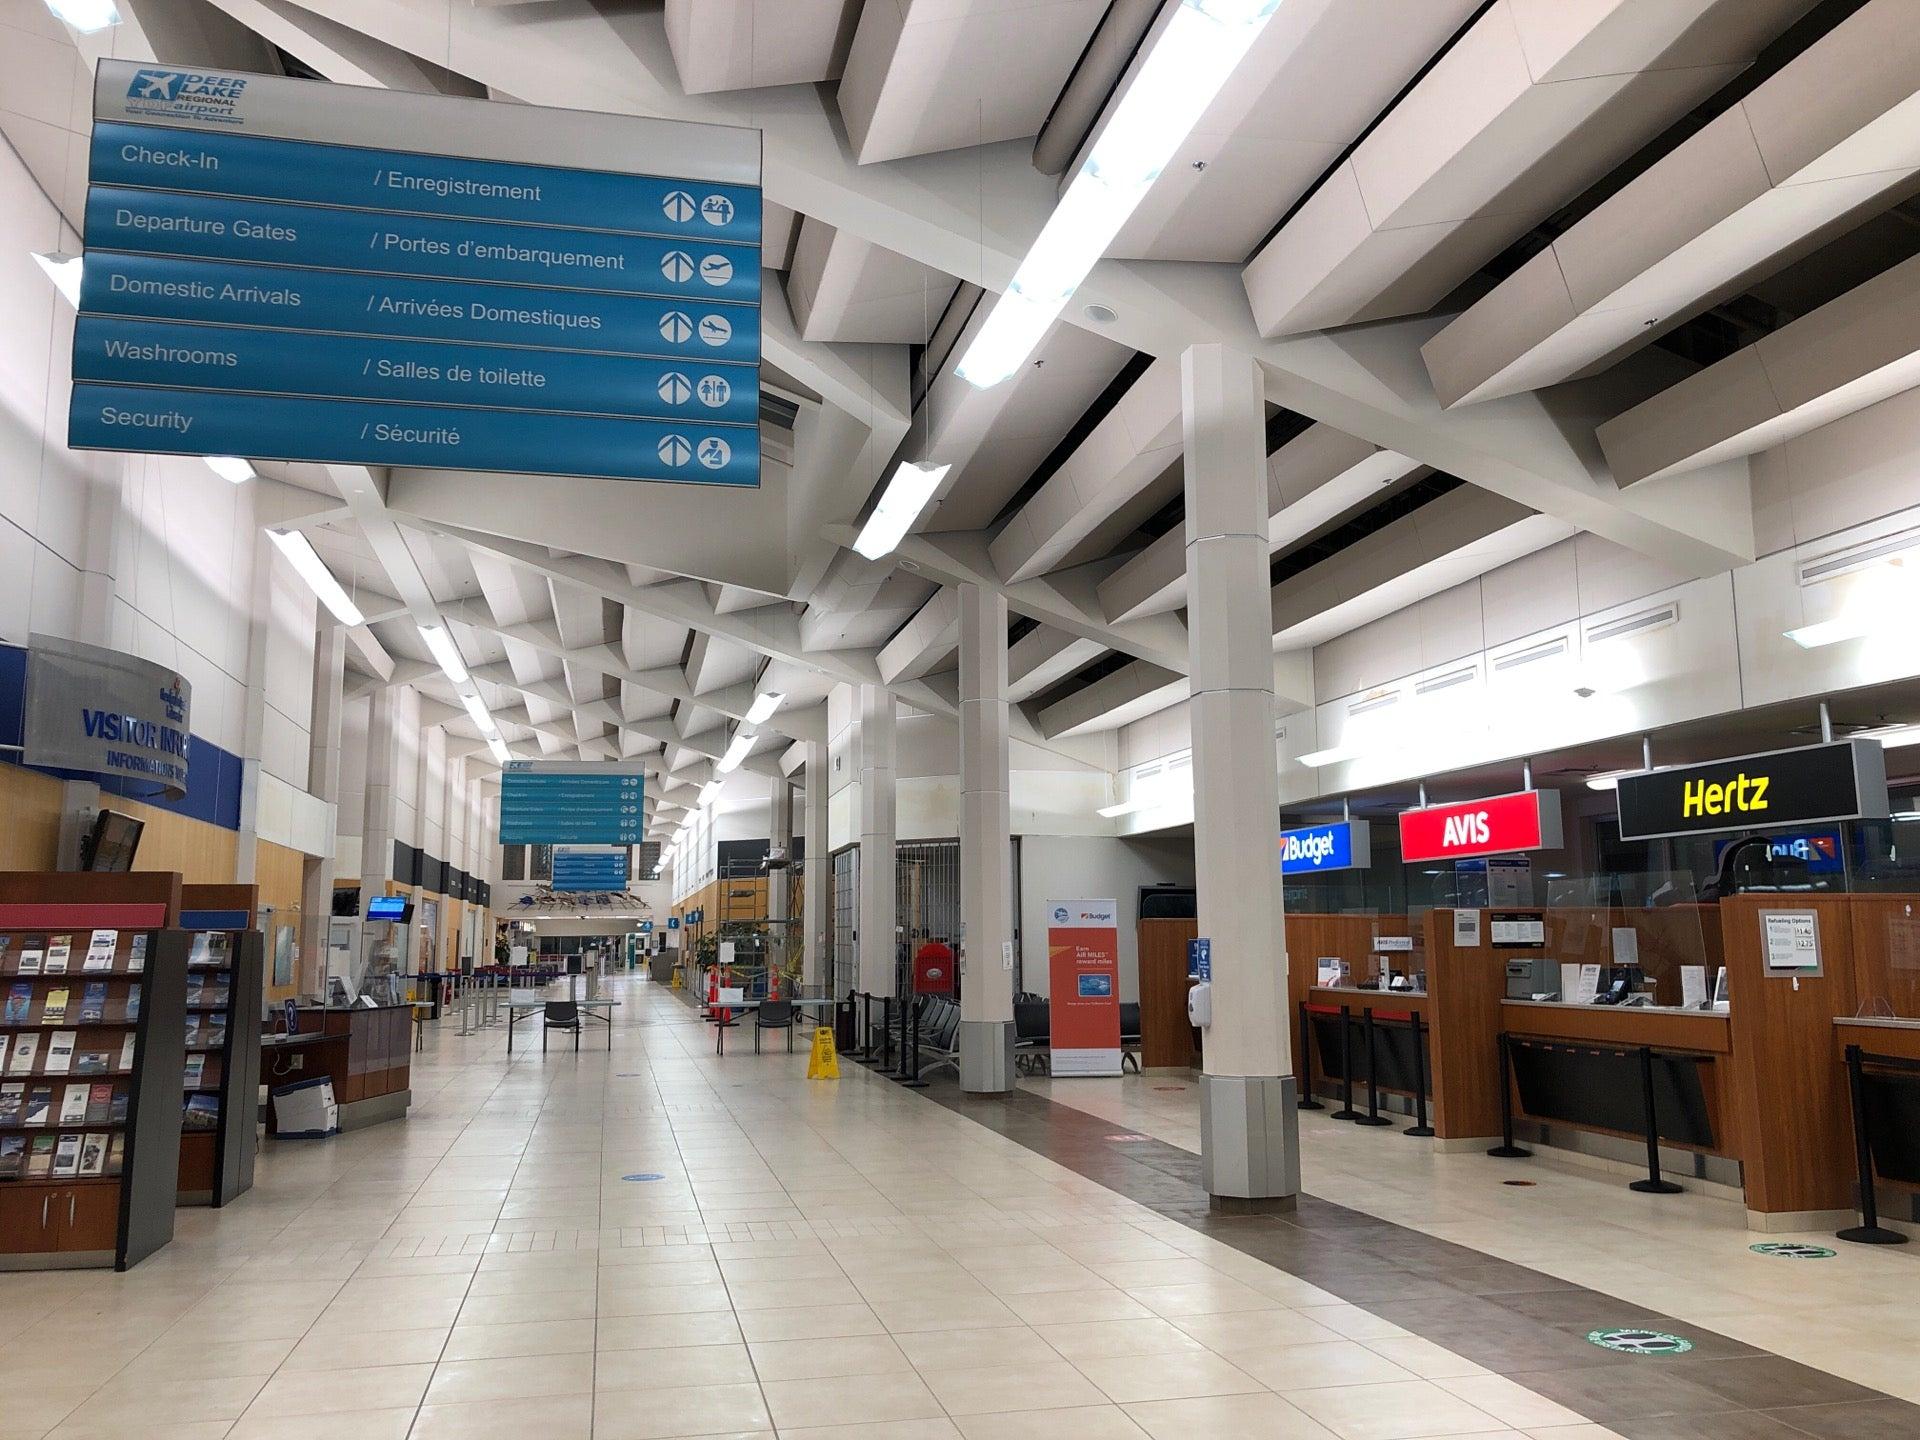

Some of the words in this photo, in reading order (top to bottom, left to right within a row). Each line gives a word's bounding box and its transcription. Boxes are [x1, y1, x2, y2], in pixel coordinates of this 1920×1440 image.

[176, 94, 237, 107] REGIONAL
[179, 84, 243, 98] LAKE
[185, 74, 247, 89] DEER
[174, 102, 234, 115] airport
[121, 144, 219, 171] Check-In
[388, 170, 542, 202] Enregistrement
[116, 208, 226, 239] Departure
[233, 219, 298, 242] Gates
[384, 233, 451, 256] Portes
[109, 273, 215, 300] Domestic
[219, 283, 302, 307] Arrivals
[378, 295, 464, 319] Arrivées
[471, 302, 602, 331] Domestiques
[104, 339, 239, 367] Washrooms
[376, 359, 440, 381] Salles
[447, 364, 472, 383] de
[478, 366, 547, 388] toilette
[100, 406, 193, 434] Security
[374, 422, 461, 446] Sécurité
[82, 708, 158, 750] VISITOR
[1683, 773, 1769, 817] Hertz
[1289, 830, 1334, 866] Budget
[1443, 811, 1490, 847] AVIS
[1089, 912, 1111, 921] Budget
